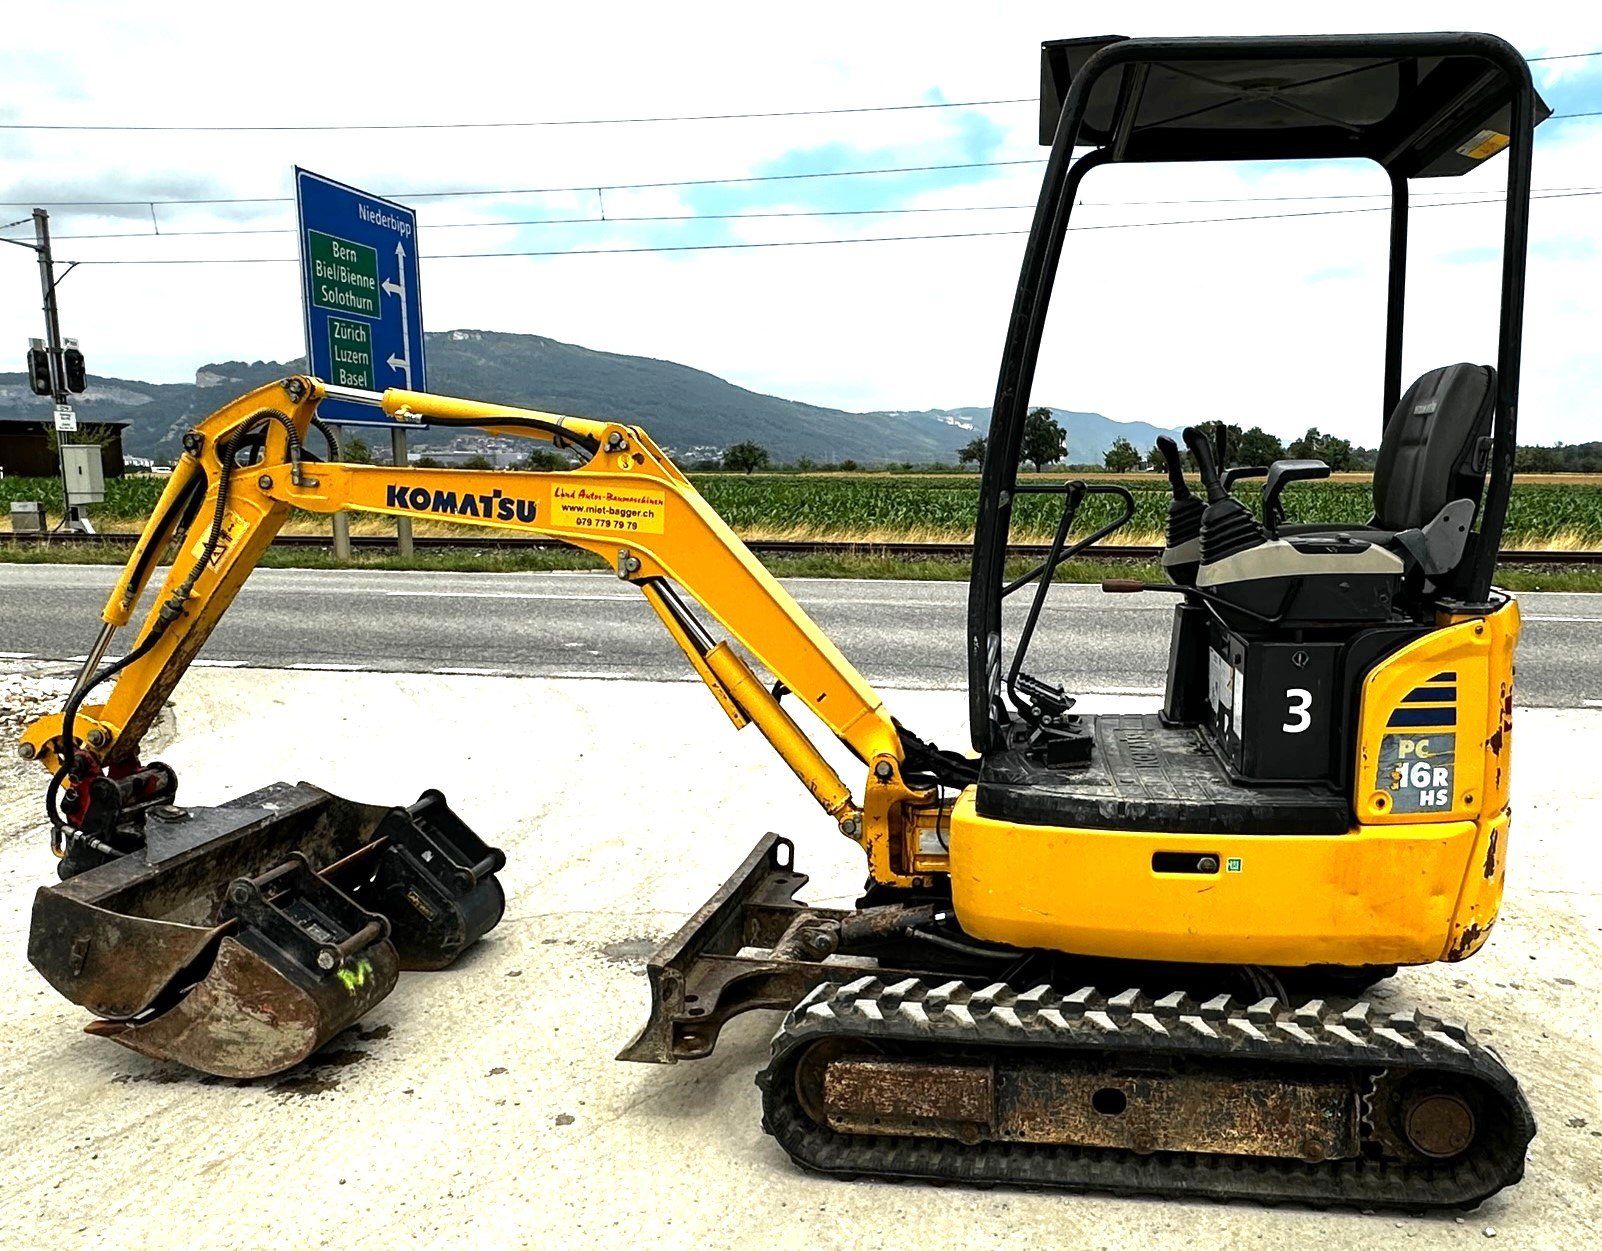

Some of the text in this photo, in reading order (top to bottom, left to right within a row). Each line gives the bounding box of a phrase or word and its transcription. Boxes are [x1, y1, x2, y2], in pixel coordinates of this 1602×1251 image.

[358, 203, 412, 238] Niederbipp
[332, 241, 357, 263] Bern
[315, 260, 376, 290] Biel/Bienne
[321, 285, 373, 311] Solothurn
[333, 322, 366, 342] Zürich
[334, 345, 369, 365] Luzern
[340, 369, 368, 388] Basel
[386, 484, 537, 523] KOMATSU
[561, 504, 655, 519] www.miet-bagger.ch
[576, 517, 638, 531] 079 779 79 79
[1282, 688, 1313, 733] 3
[1398, 739, 1430, 759] PC
[1395, 761, 1449, 789] 16R
[1419, 788, 1448, 807] HS
